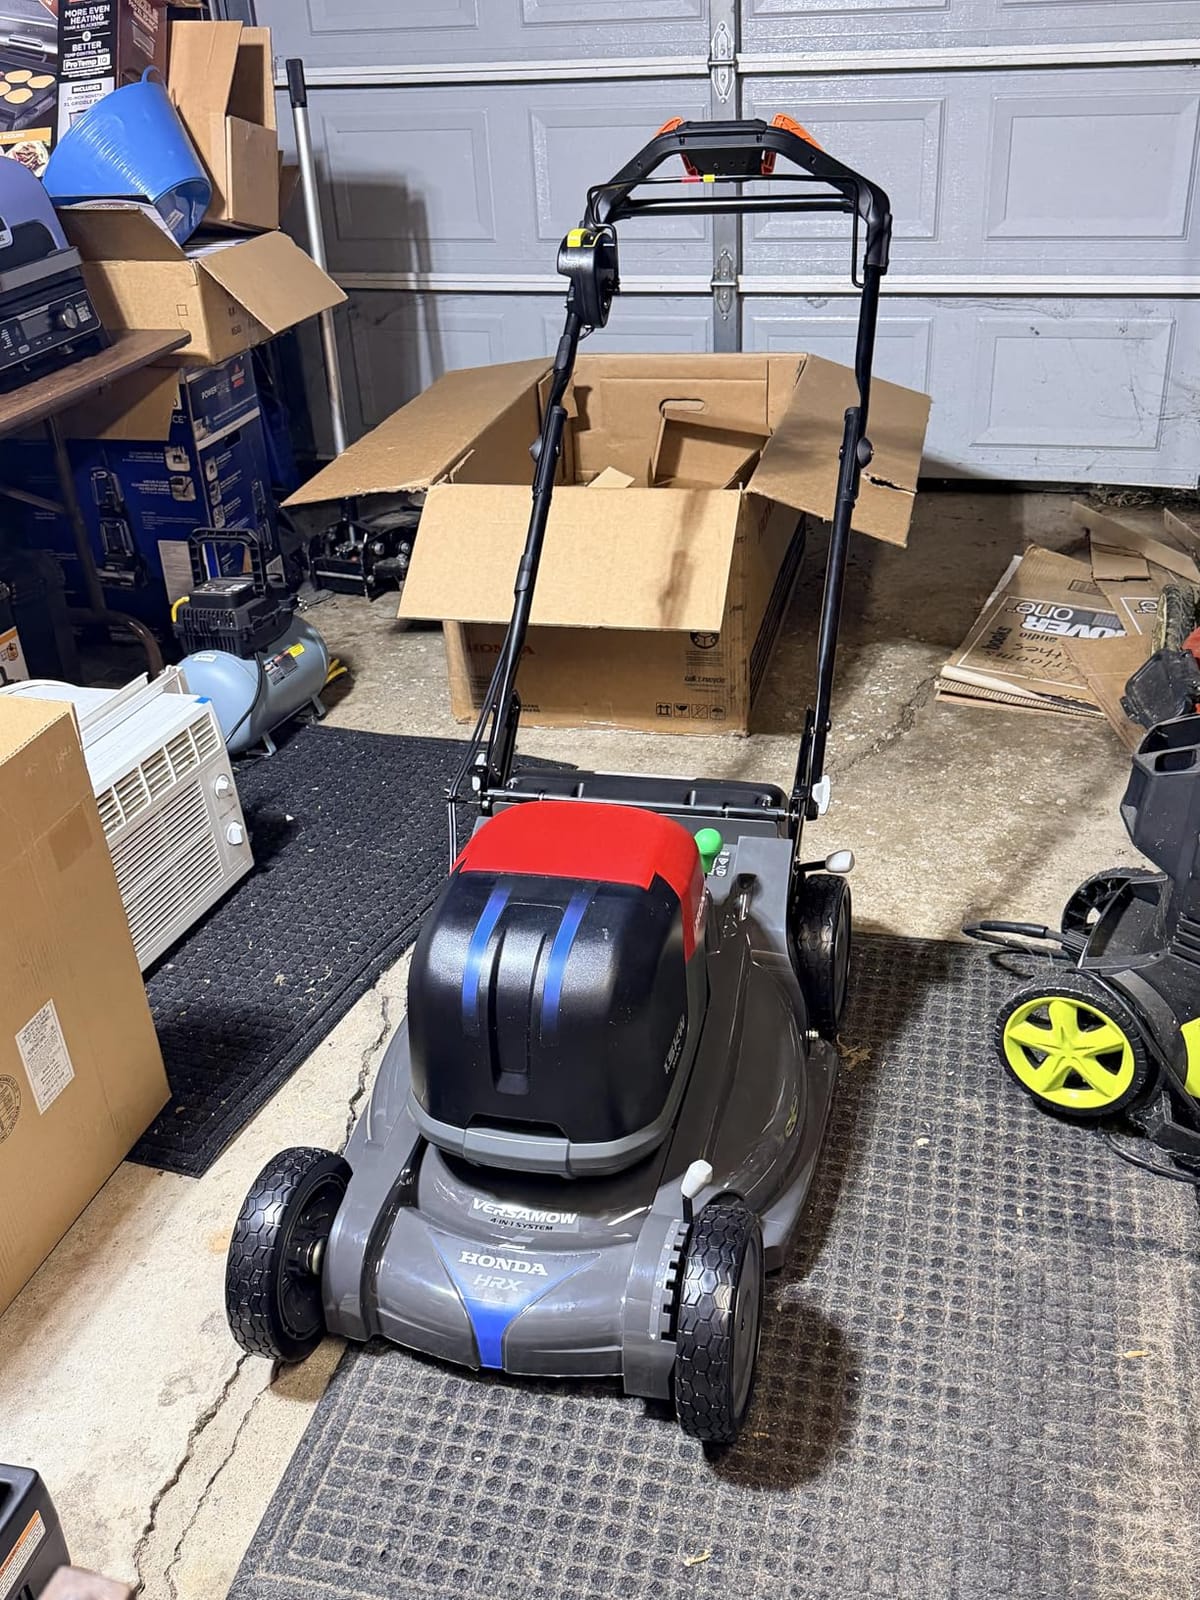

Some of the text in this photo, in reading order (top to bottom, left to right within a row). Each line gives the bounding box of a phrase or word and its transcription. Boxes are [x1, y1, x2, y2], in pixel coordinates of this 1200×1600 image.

[65, 4, 110, 18] MORE EVEN
[71, 13, 104, 25] HEATING
[72, 41, 102, 52] BETTER
[65, 58, 97, 69] ProTemp
[1016, 602, 1073, 621] one
[1019, 633, 1058, 643] audio
[1012, 642, 1073, 662] thes
[984, 650, 1069, 672] irlooms
[473, 1197, 578, 1225] VERSAMOW
[515, 1221, 554, 1232] SYSTEM
[458, 1250, 549, 1276] HONDA
[473, 1273, 525, 1292] HRX
